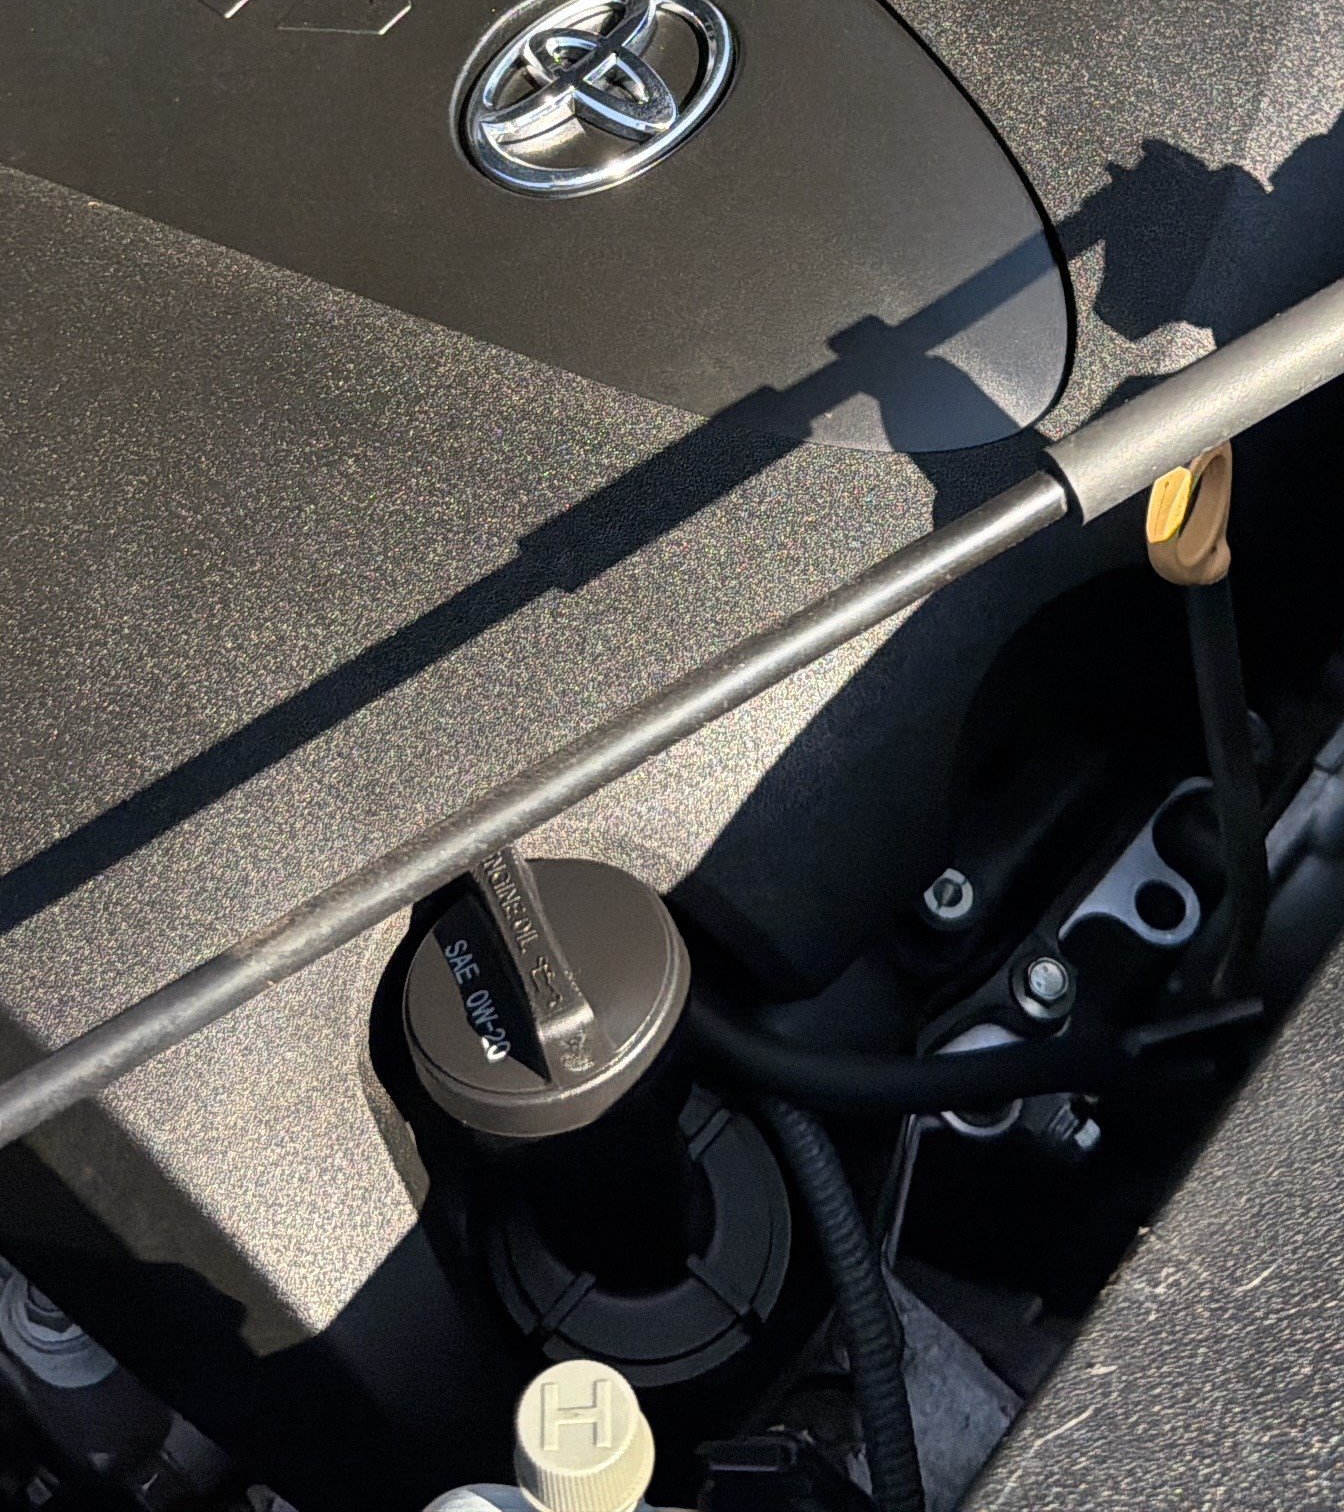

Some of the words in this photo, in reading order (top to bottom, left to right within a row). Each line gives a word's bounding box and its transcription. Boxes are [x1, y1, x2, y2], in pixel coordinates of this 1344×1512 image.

[481, 850, 526, 919] NGINE
[443, 938, 480, 986] SAE
[465, 988, 512, 1064] 0W-20
[540, 1377, 613, 1452] H
